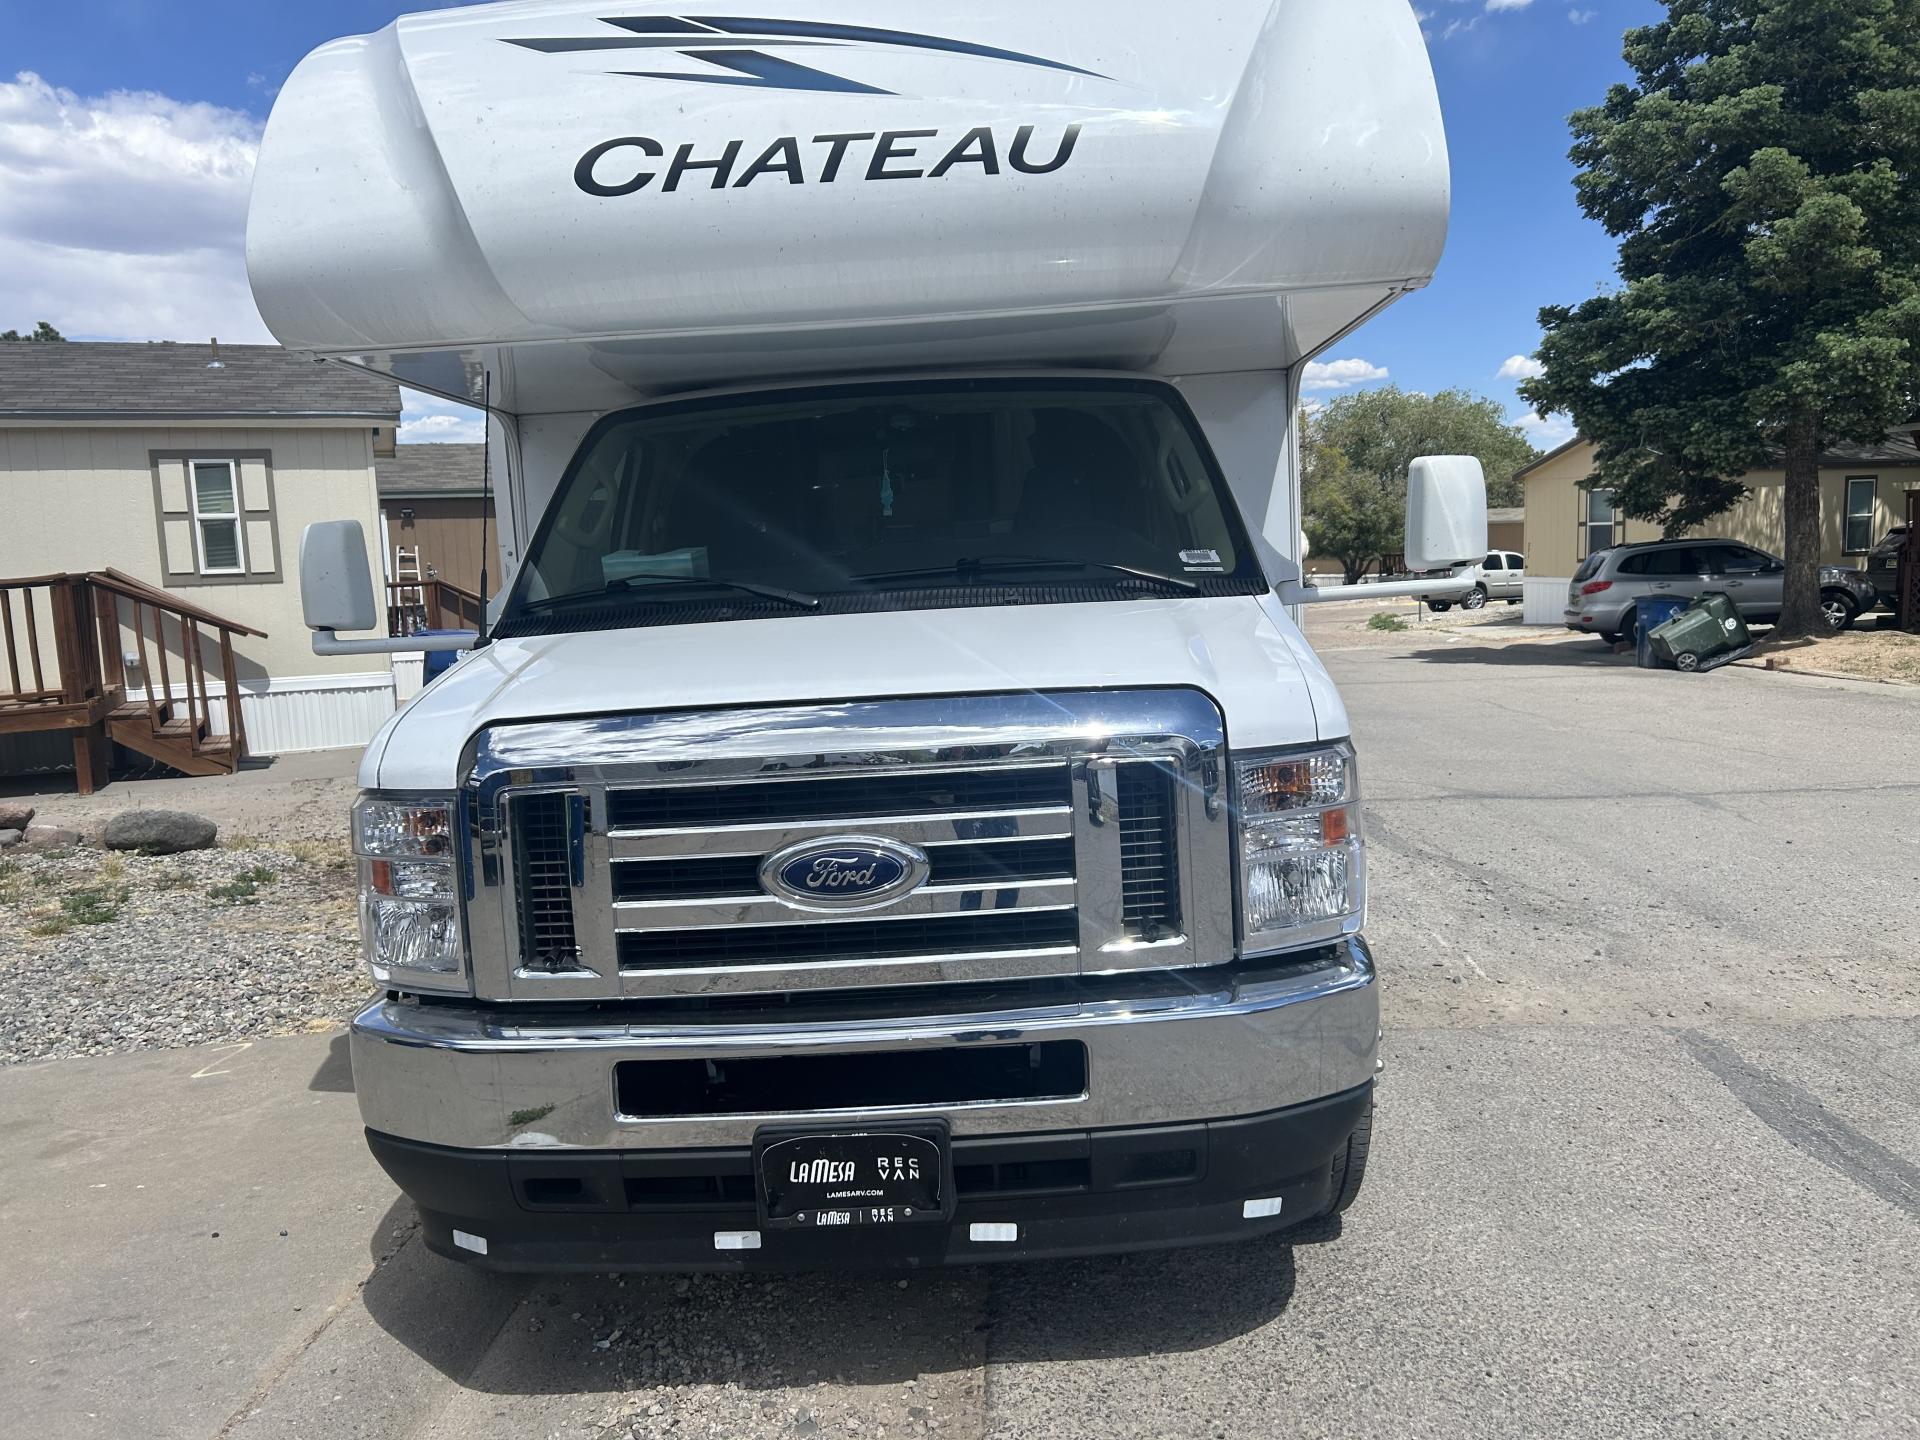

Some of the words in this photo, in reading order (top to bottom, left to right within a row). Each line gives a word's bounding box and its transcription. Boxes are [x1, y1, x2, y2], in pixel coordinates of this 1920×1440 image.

[573, 124, 1082, 197] CHATEAU
[806, 857, 877, 888] Ford
[877, 1157, 919, 1168] REC
[878, 1168, 920, 1180] VAN
[826, 1189, 884, 1198] LAMESARV.COM
[872, 1215, 894, 1223] VAN
